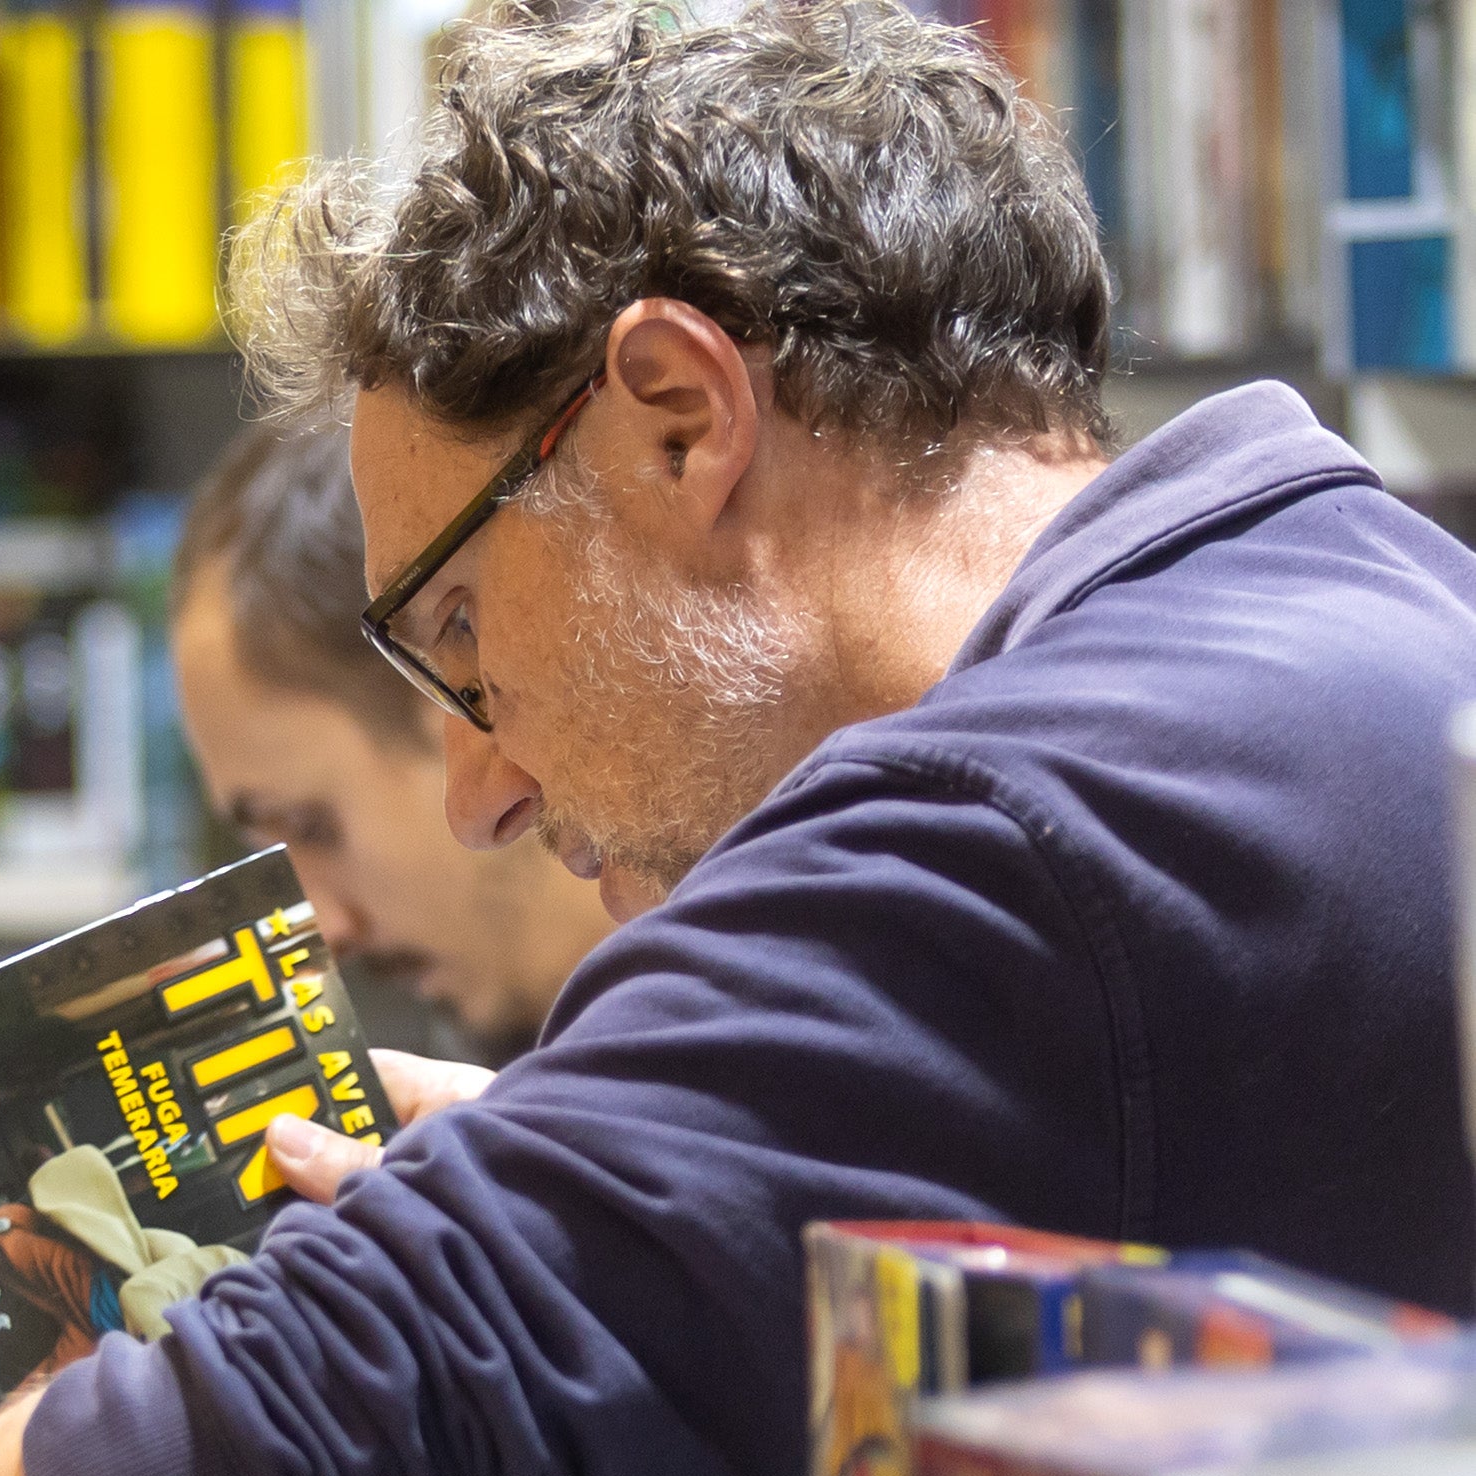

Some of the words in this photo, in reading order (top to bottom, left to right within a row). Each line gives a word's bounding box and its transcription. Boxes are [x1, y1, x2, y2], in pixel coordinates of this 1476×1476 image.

[278, 947, 336, 1034] LAS
[95, 1030, 179, 1201] TEMERARIA
[140, 1060, 190, 1146] FUGA
